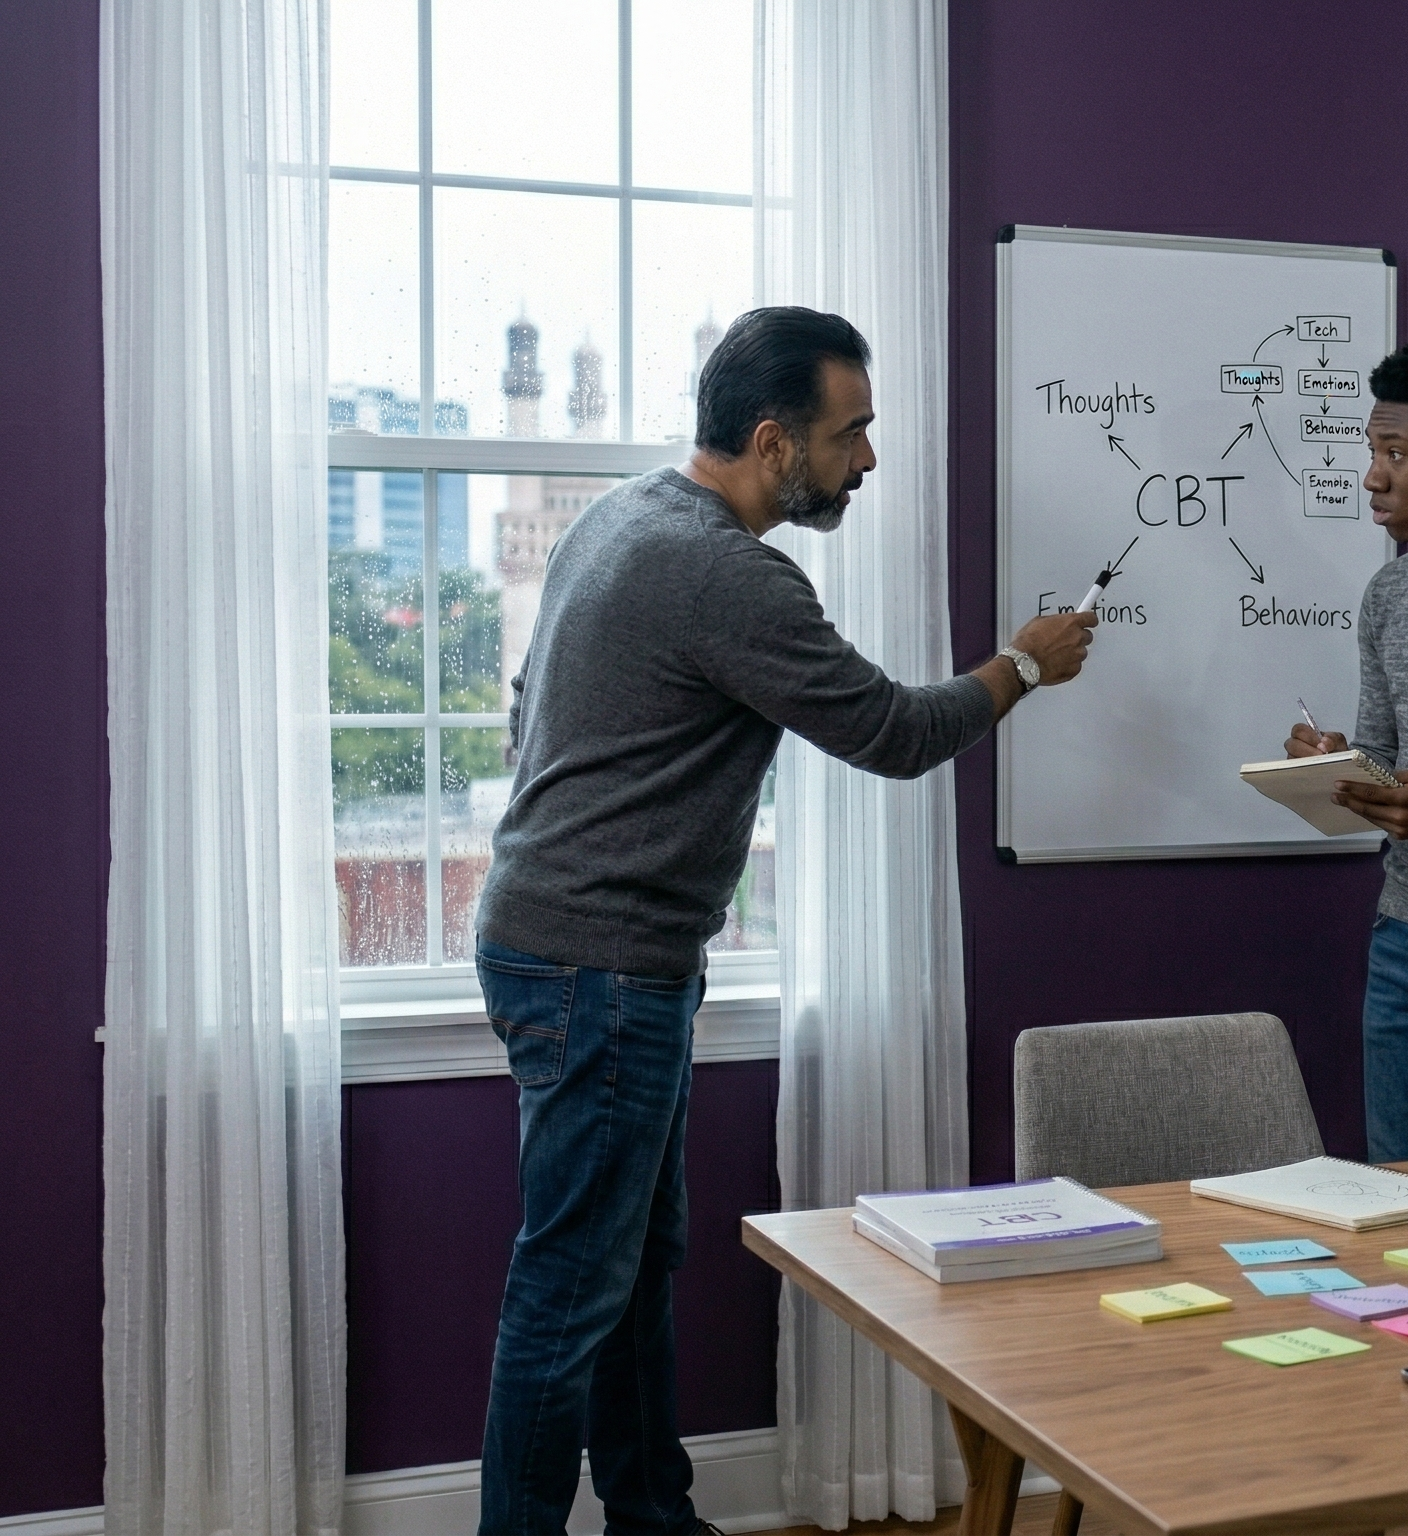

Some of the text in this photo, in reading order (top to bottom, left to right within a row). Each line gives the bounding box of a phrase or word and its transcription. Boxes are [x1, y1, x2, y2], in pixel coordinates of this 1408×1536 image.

[1303, 320, 1338, 337] Tech
[1224, 369, 1281, 392] Thoughts
[1303, 374, 1356, 392] Emotions
[1036, 379, 1156, 430] Thoughts
[1304, 419, 1362, 436] Behaviors
[1136, 473, 1245, 527] CBT
[1038, 591, 1147, 625] Emtions
[1239, 594, 1352, 630] Behaviors
[977, 1211, 1063, 1227] CBT
